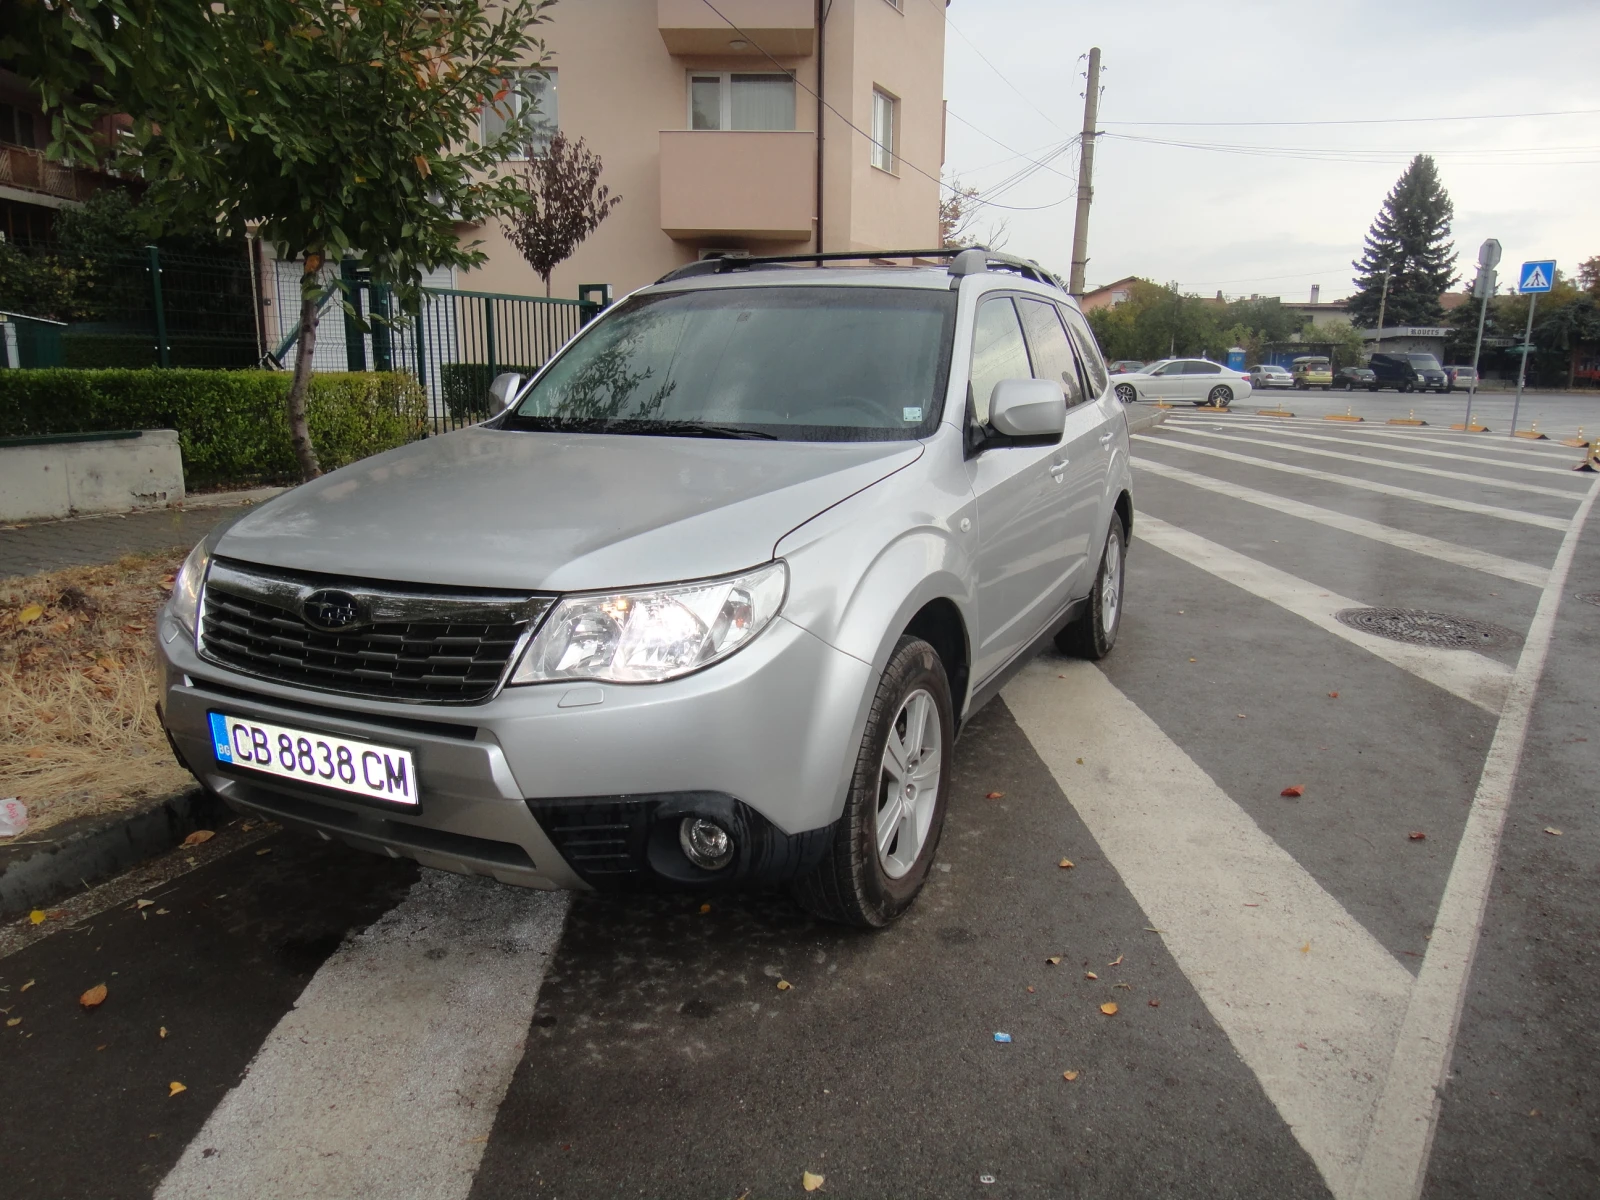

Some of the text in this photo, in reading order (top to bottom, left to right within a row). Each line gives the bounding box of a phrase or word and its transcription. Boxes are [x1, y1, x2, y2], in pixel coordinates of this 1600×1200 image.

[218, 744, 231, 756] BG
[233, 724, 408, 797] CB 8838 CM
